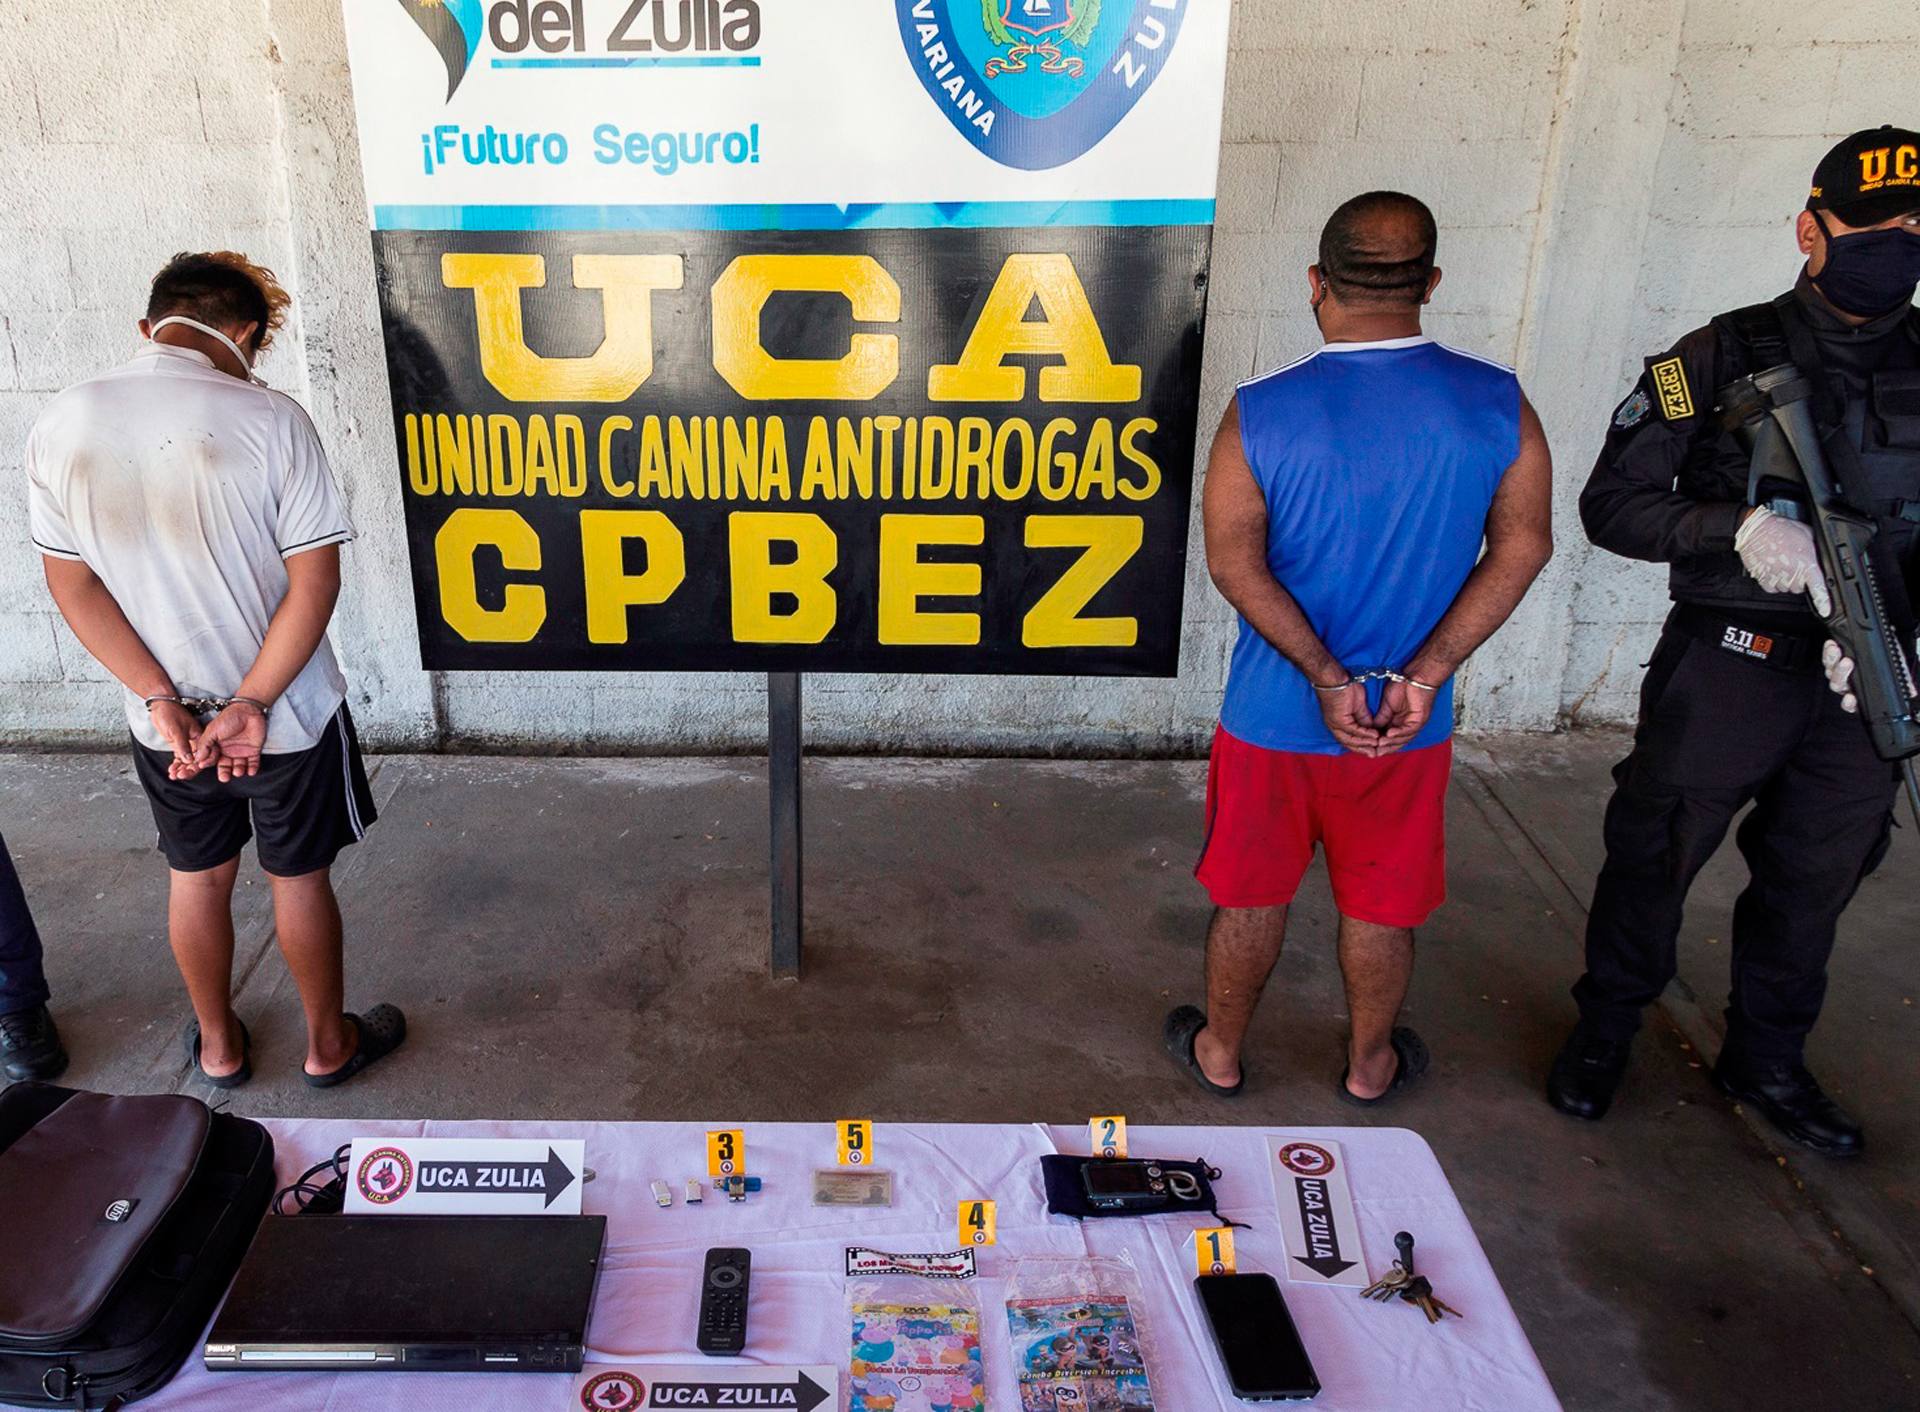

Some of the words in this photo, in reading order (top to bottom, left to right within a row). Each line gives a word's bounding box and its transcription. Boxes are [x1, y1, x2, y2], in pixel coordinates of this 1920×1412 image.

[488, 0, 586, 53] del
[606, 0, 761, 52] Zulia
[421, 124, 569, 175] ¡Futuro
[592, 123, 760, 176] Seguro!
[440, 253, 1142, 403] UCA
[404, 412, 588, 497] UNIDAD
[598, 414, 792, 502] CANINA
[799, 414, 1163, 502] ANTIDROGAS
[433, 508, 1144, 649] CPBEZ
[1723, 625, 1754, 648] 5.11
[718, 1132, 734, 1161] 3
[847, 1123, 864, 1150] 5
[1101, 1119, 1117, 1147] 2
[420, 1167, 469, 1188] UCA
[474, 1168, 546, 1188] ZULIA
[1301, 1180, 1325, 1210] UCA
[968, 1202, 986, 1230] 4
[1206, 1231, 1221, 1262] 1
[1307, 1212, 1334, 1259] ZULIA
[207, 1344, 236, 1353] PHILIPS
[654, 1387, 710, 1404] UCA
[716, 1387, 797, 1404] ZULIA
